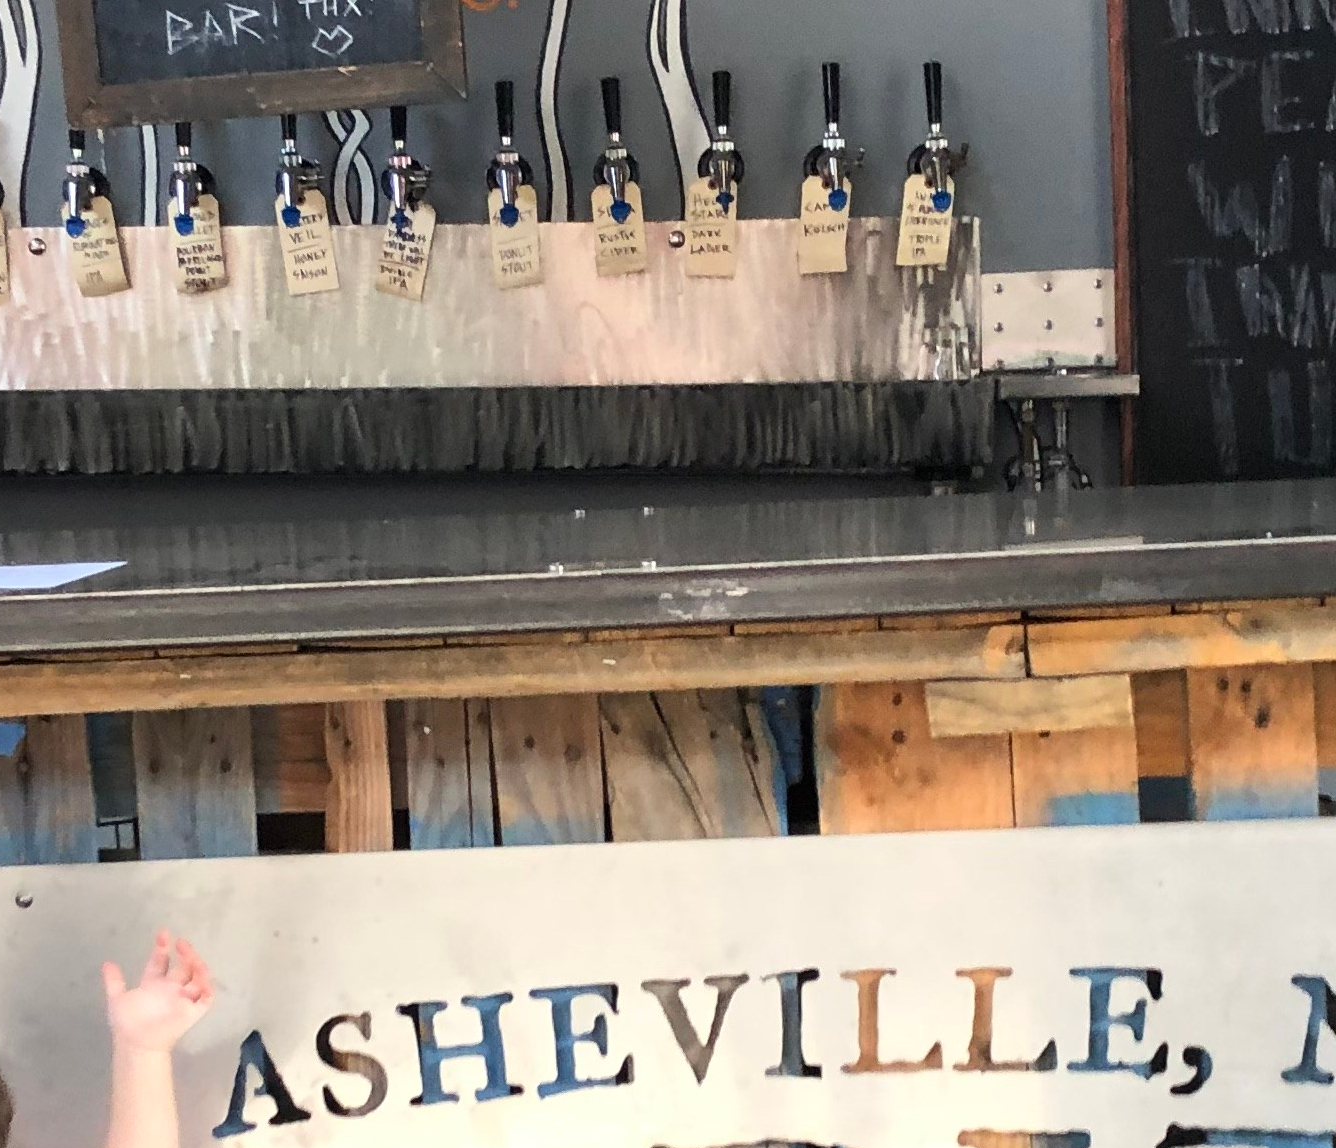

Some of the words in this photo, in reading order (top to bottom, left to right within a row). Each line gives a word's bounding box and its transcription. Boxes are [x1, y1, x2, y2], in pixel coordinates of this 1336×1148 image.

[165, 2, 279, 55] BAR!
[288, 231, 321, 246] VEIL
[293, 249, 328, 266] HONEY
[212, 966, 1215, 1138] ASHEVILLE,
